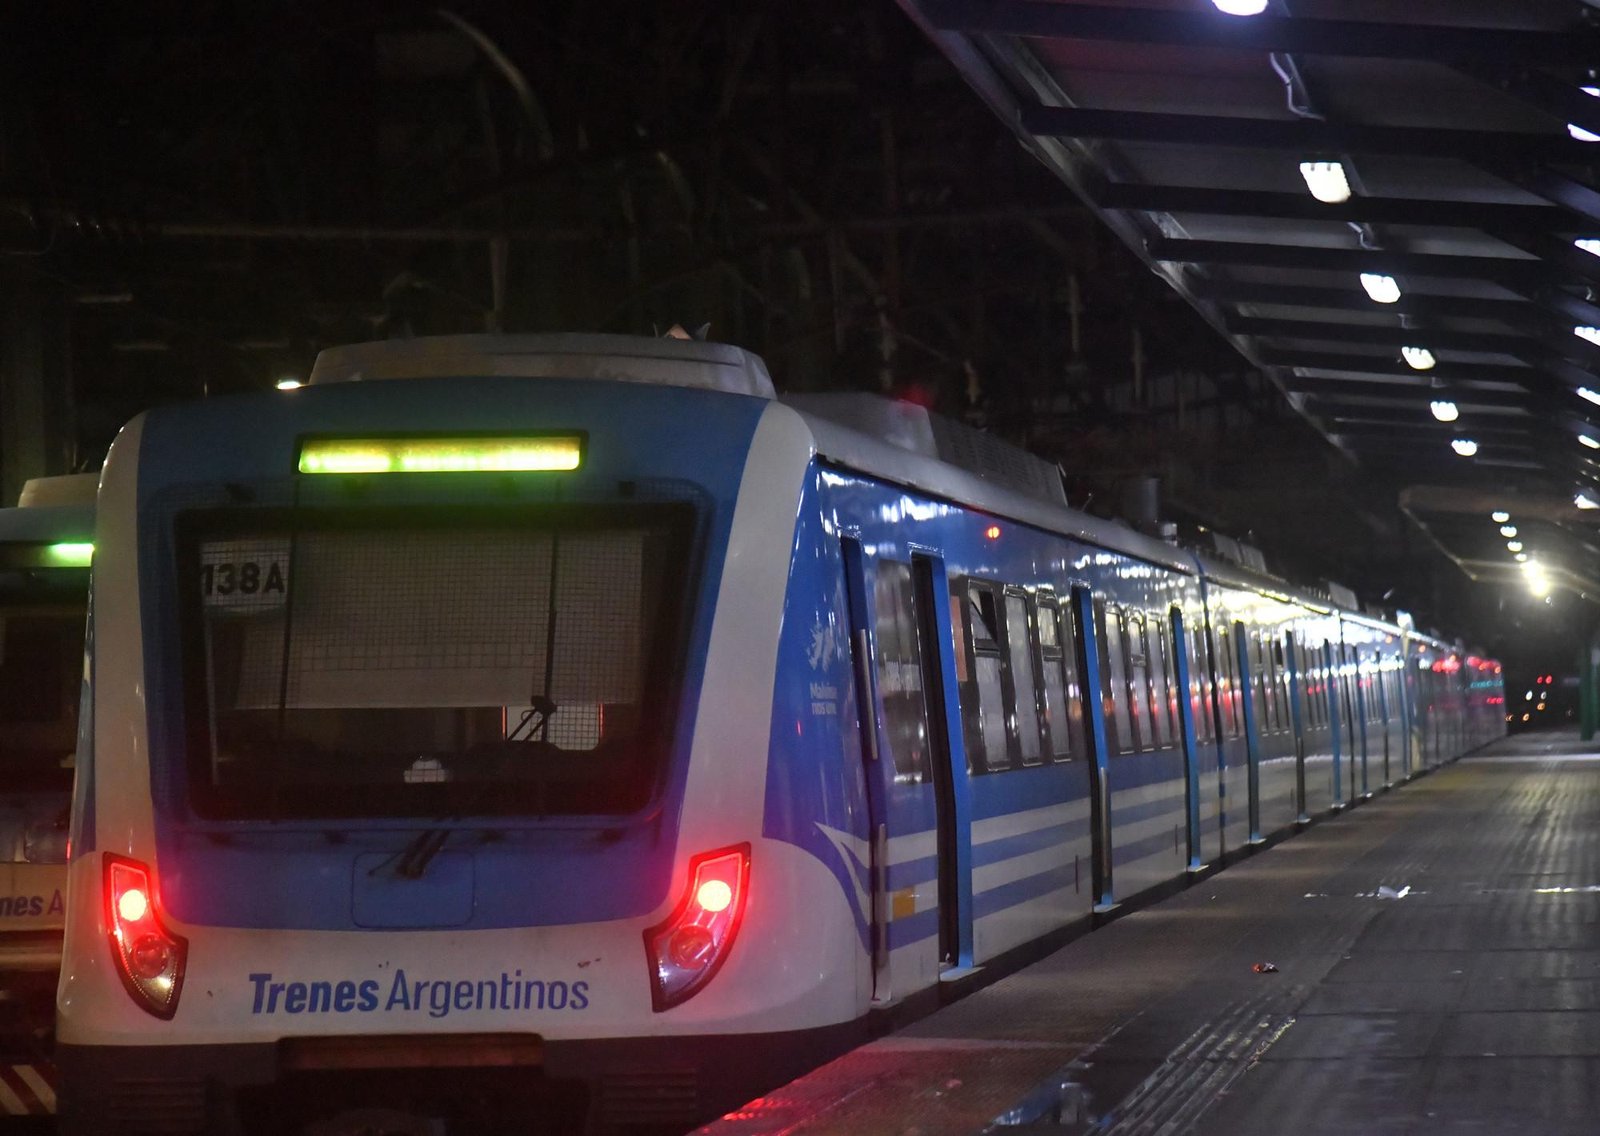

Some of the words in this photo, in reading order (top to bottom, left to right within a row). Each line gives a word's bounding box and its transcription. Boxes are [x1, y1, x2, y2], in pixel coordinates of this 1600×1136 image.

[202, 562, 286, 596] 138A
[249, 973, 379, 1014] Trenes
[385, 969, 589, 1018] Argentinos
